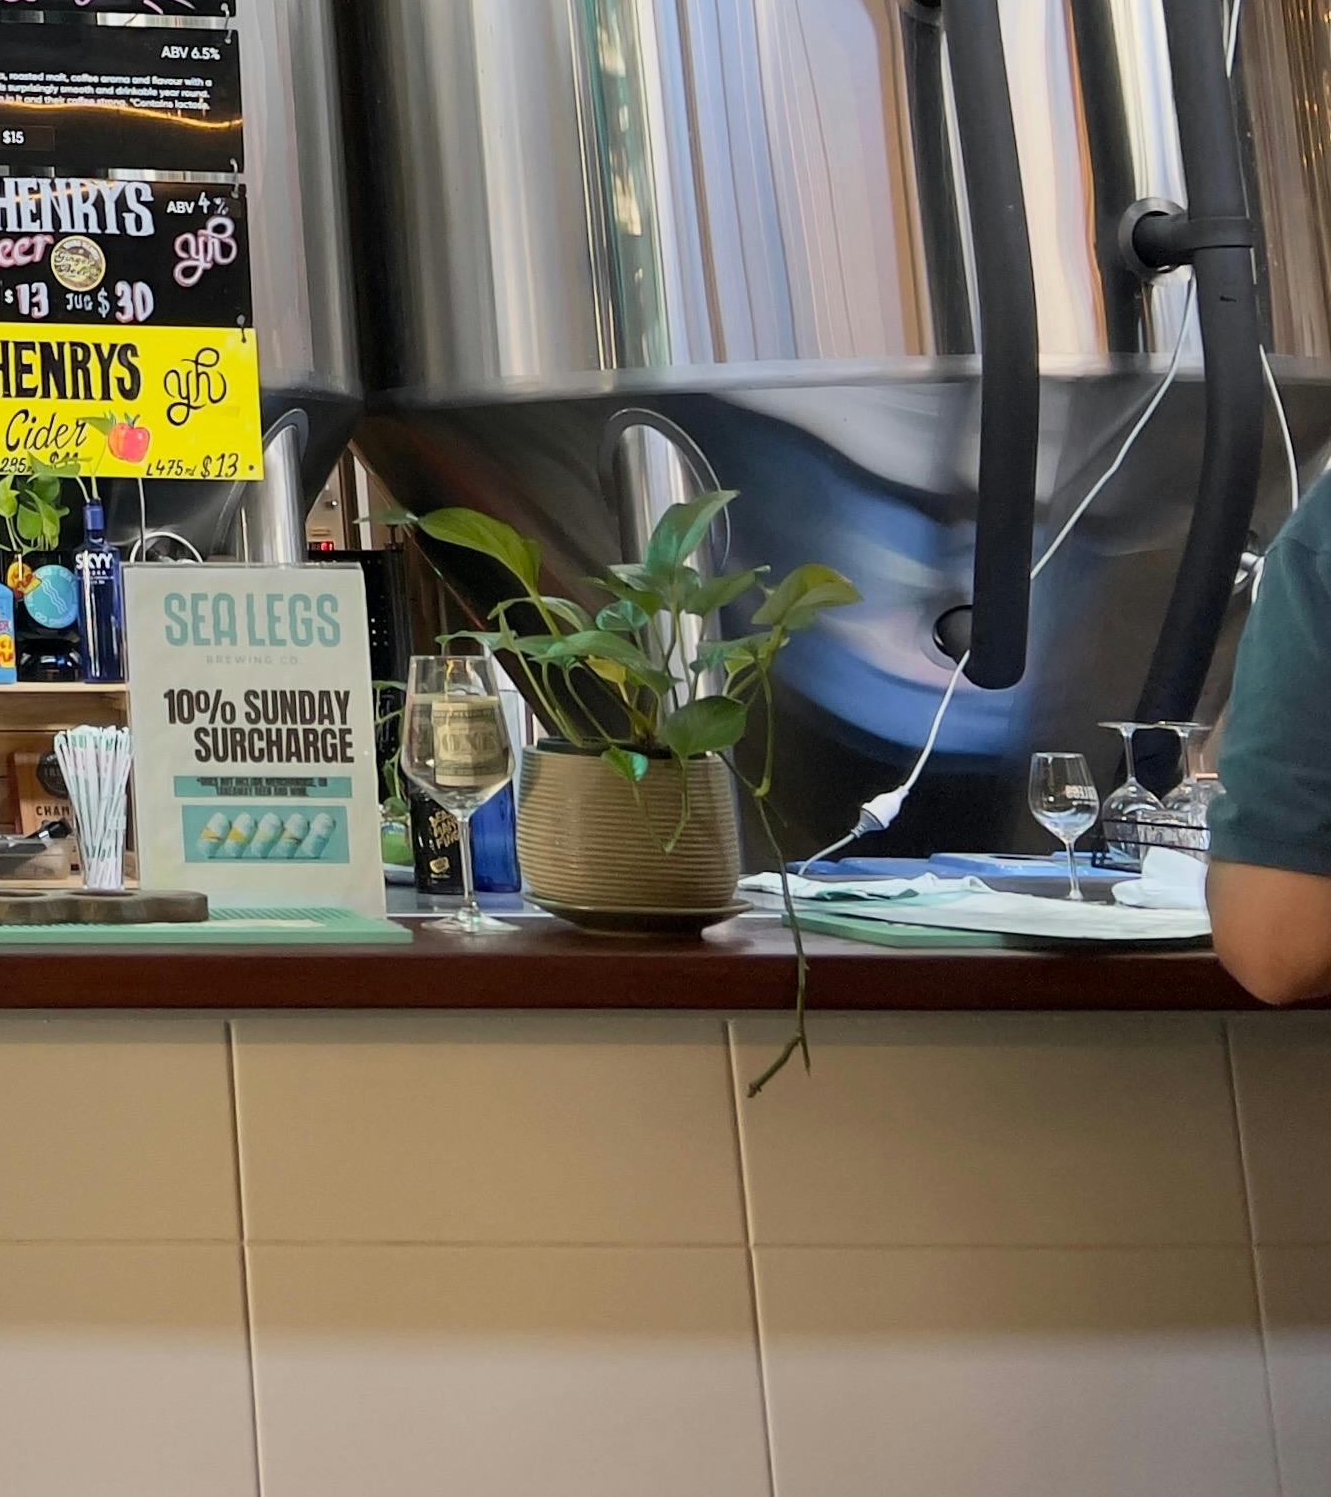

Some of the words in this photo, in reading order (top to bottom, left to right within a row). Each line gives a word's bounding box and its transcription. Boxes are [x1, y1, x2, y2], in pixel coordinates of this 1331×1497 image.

[161, 46, 188, 59] ABV
[191, 46, 220, 60] 6.5%
[2, 130, 24, 145] $15
[166, 199, 194, 214] ABV
[5, 408, 88, 450] Cider
[164, 592, 237, 646] SEA
[246, 593, 341, 647] LEGS
[206, 656, 273, 664] BREWING
[163, 689, 236, 724] 10%
[244, 689, 350, 725] SUNDAY
[194, 727, 354, 763] SURCHARGE
